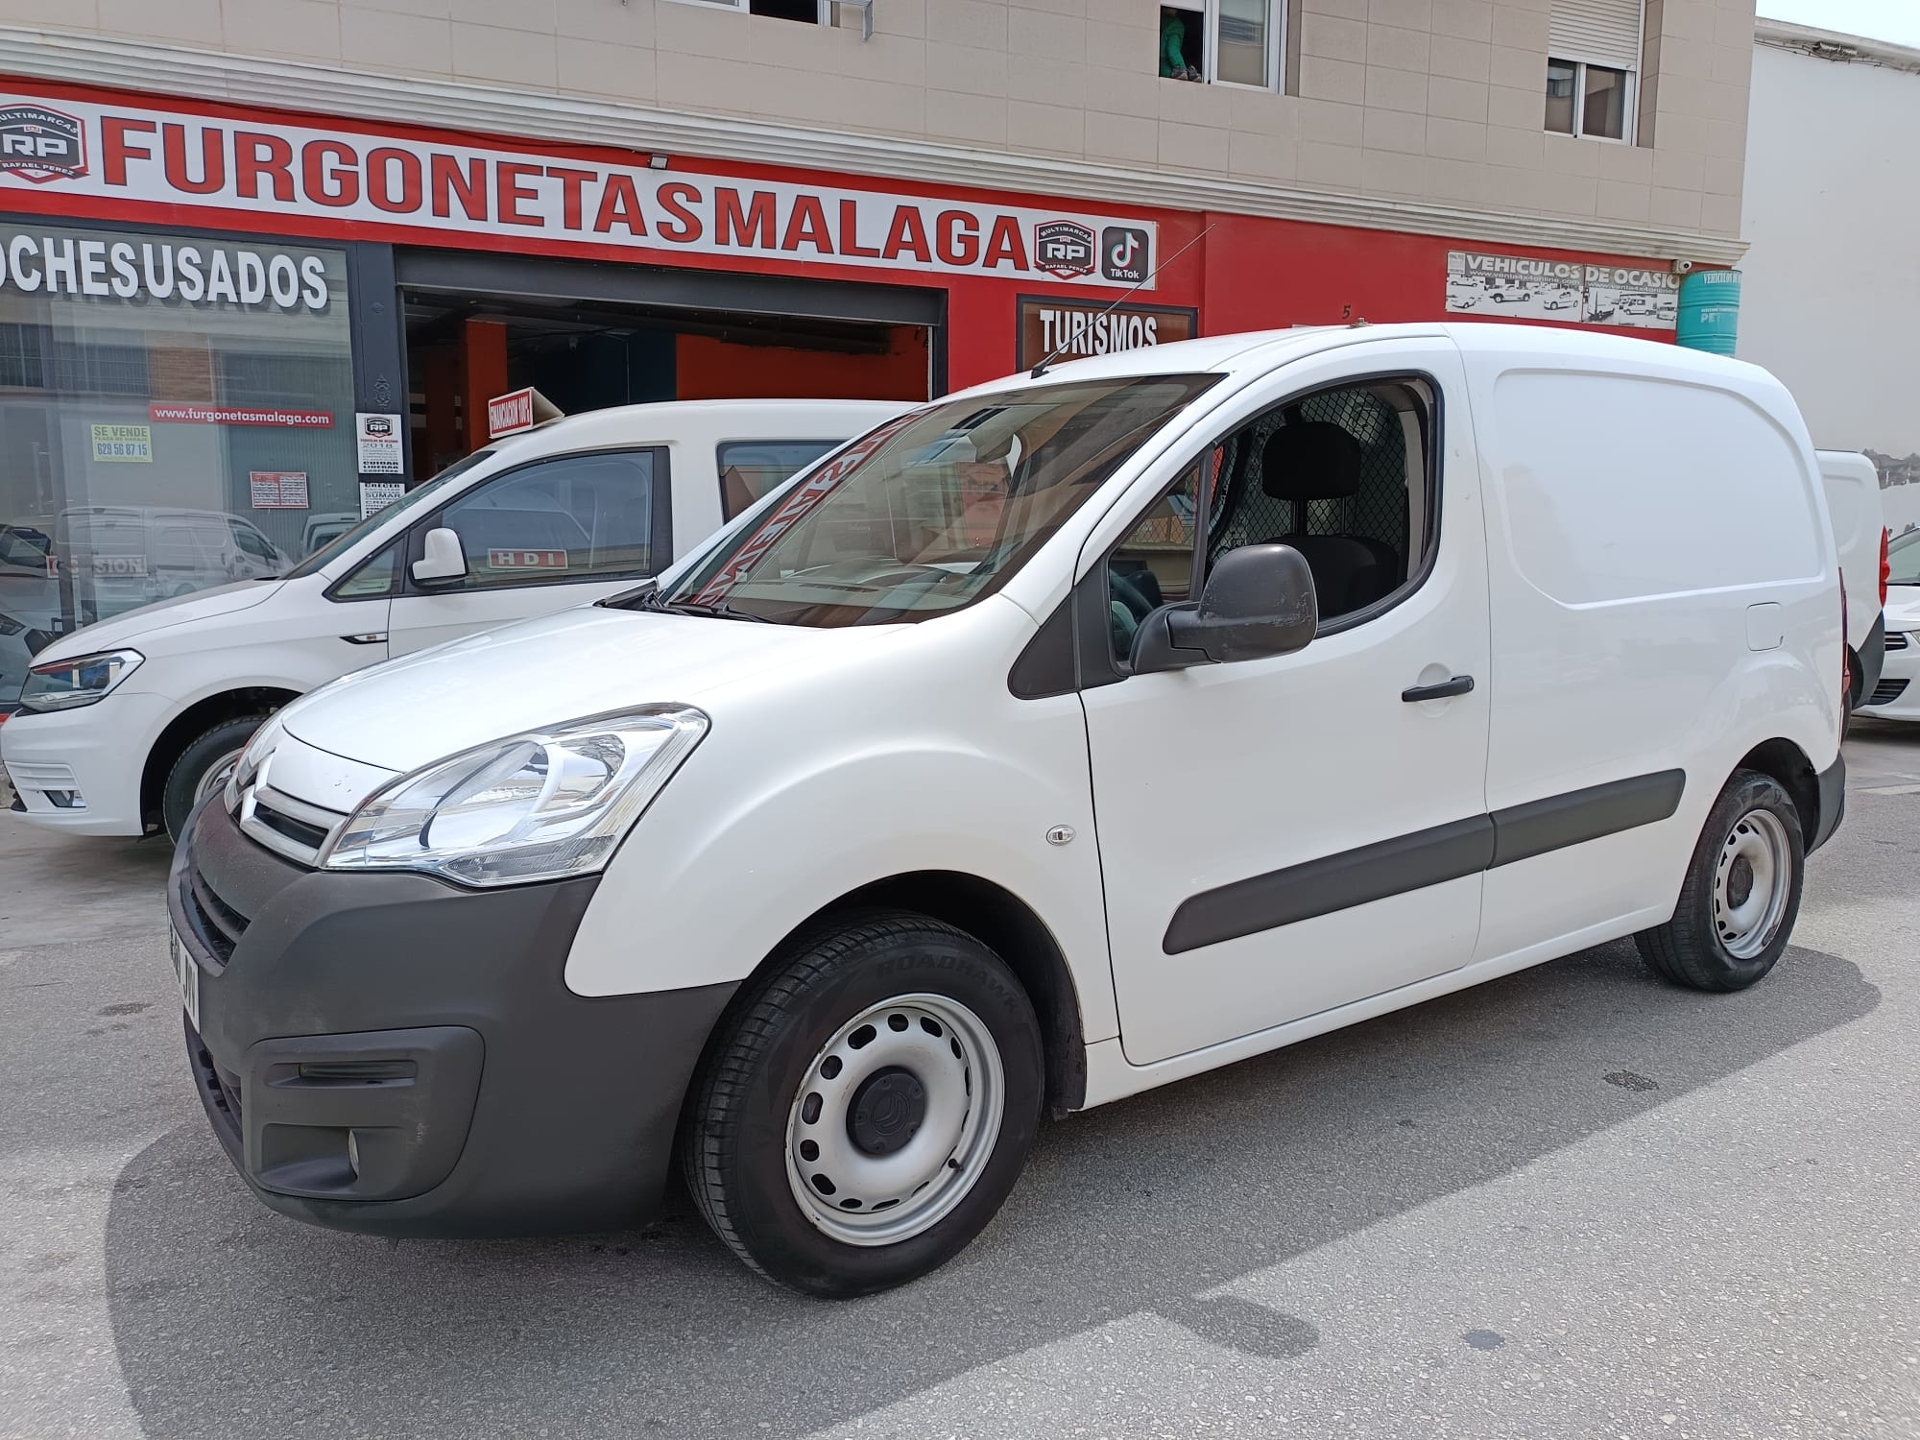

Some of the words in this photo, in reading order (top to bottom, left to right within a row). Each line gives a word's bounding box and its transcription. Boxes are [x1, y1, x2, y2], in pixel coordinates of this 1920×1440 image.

[0, 113, 79, 134] ULTIMARCAS
[3, 134, 68, 157] RP
[1040, 226, 1092, 242] MULTIMARCAS
[1046, 243, 1085, 260] RP
[0, 234, 328, 310] CHESUSADOS
[1068, 265, 1088, 274] PEREZ
[1110, 268, 1140, 279] TikTok
[1466, 254, 1581, 280] VEHICULOS
[1586, 265, 1606, 282] DE
[1341, 304, 1351, 319] 5
[1039, 309, 1157, 355] TURISMOS
[155, 408, 329, 425] www.furgonetasmalaga.com
[94, 426, 108, 436] SE
[111, 426, 147, 437] VENDE
